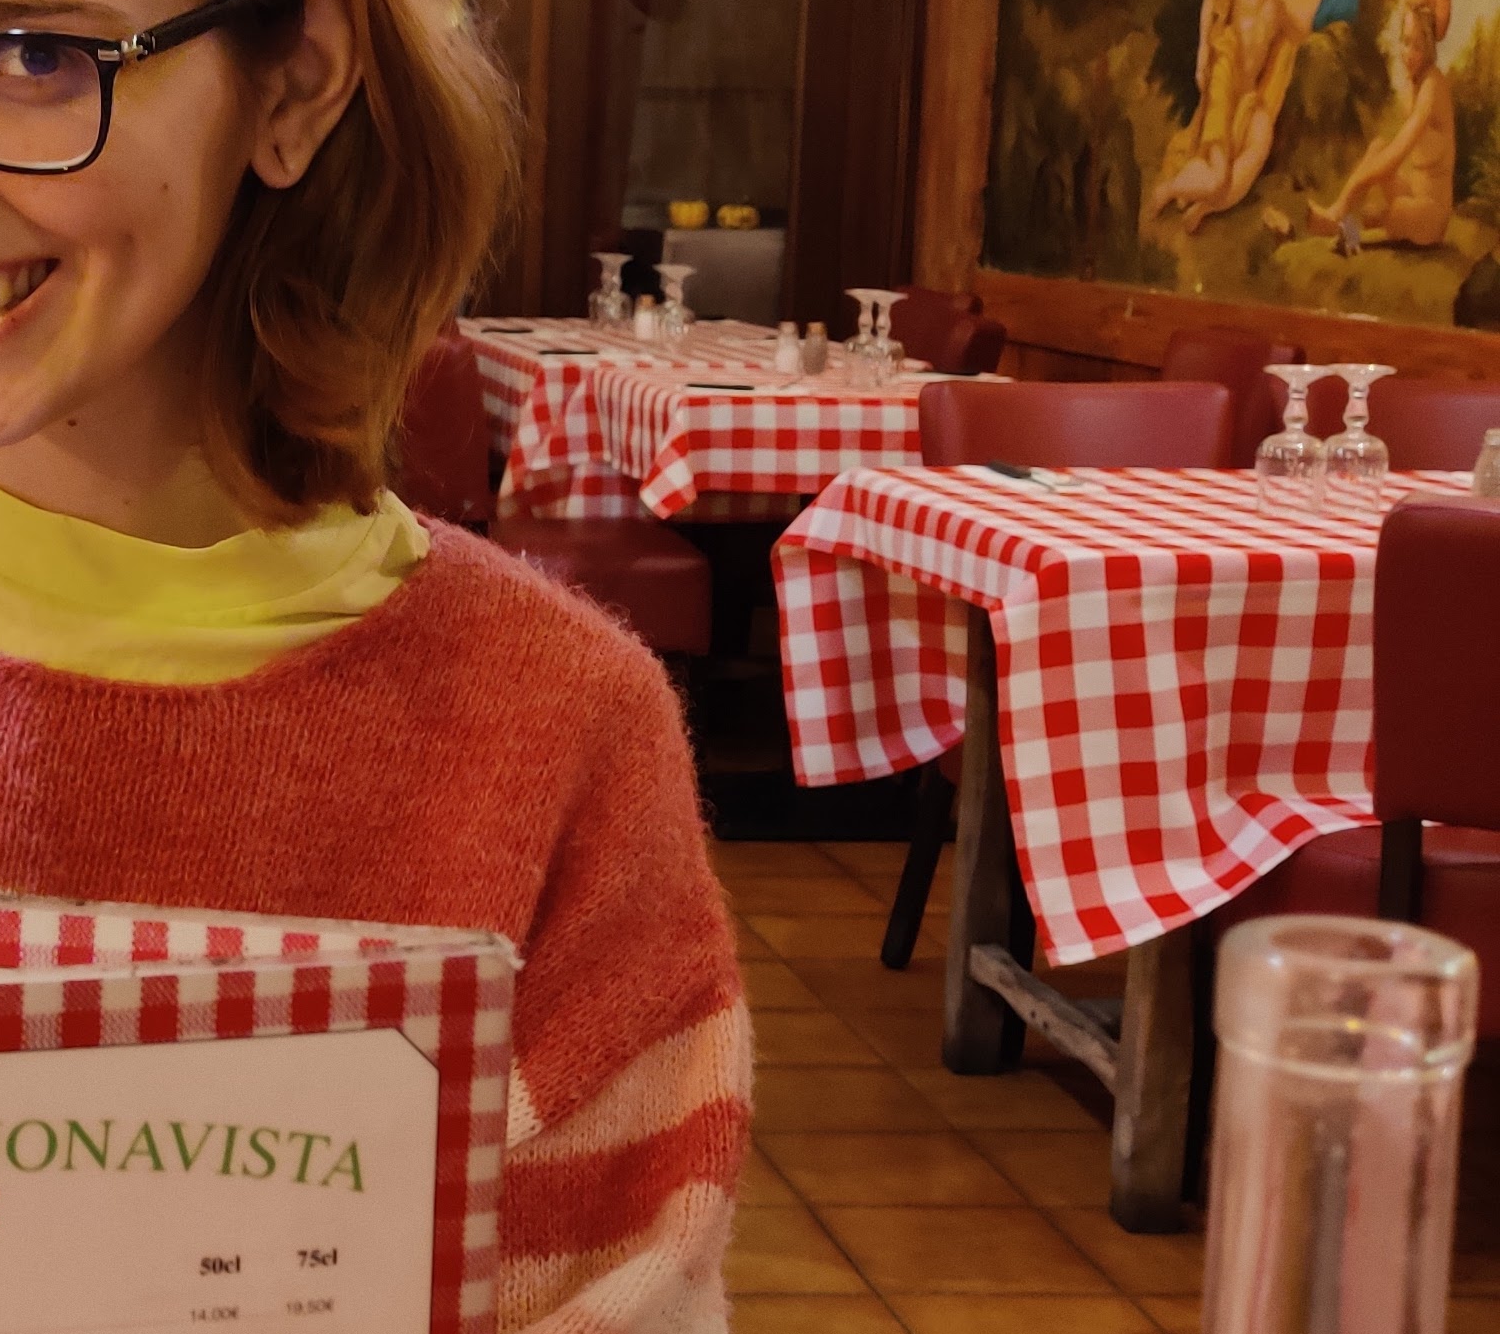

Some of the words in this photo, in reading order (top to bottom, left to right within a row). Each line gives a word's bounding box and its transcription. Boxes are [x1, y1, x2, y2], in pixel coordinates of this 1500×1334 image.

[198, 1255, 241, 1276] 50cl
[297, 1247, 338, 1269] 75cl
[190, 1306, 240, 1324] 14.00€
